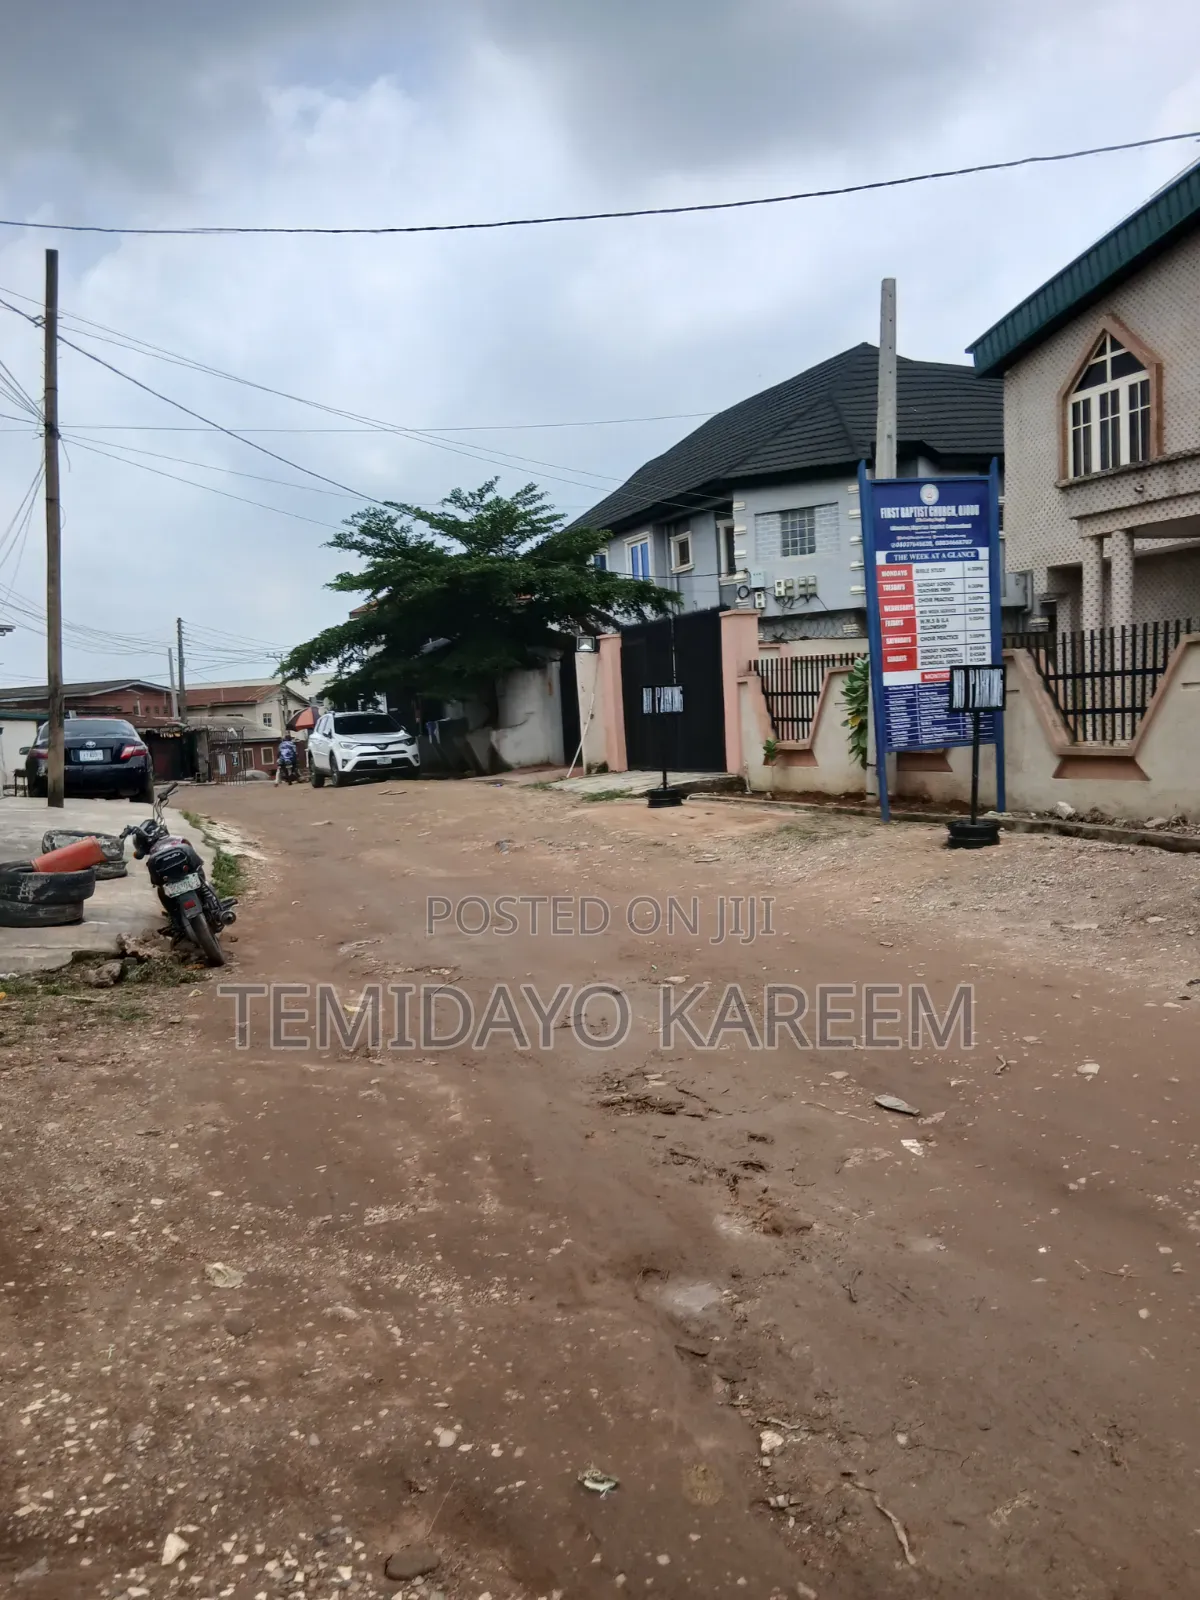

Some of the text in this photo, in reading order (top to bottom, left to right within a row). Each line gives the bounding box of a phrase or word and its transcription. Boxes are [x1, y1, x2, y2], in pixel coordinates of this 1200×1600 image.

[880, 507, 900, 519] FIRST
[900, 506, 929, 518] BAPTIST
[894, 551, 976, 561] THE WEEK AT A GLANCE
[881, 569, 908, 577] MONDAYS
[882, 583, 906, 592] TUESDAYS
[883, 603, 914, 612] WEDNESDAYS
[885, 636, 912, 645] SATURDAYS
[953, 668, 1004, 709] NO PARKING
[643, 685, 684, 714] NO PARKING
